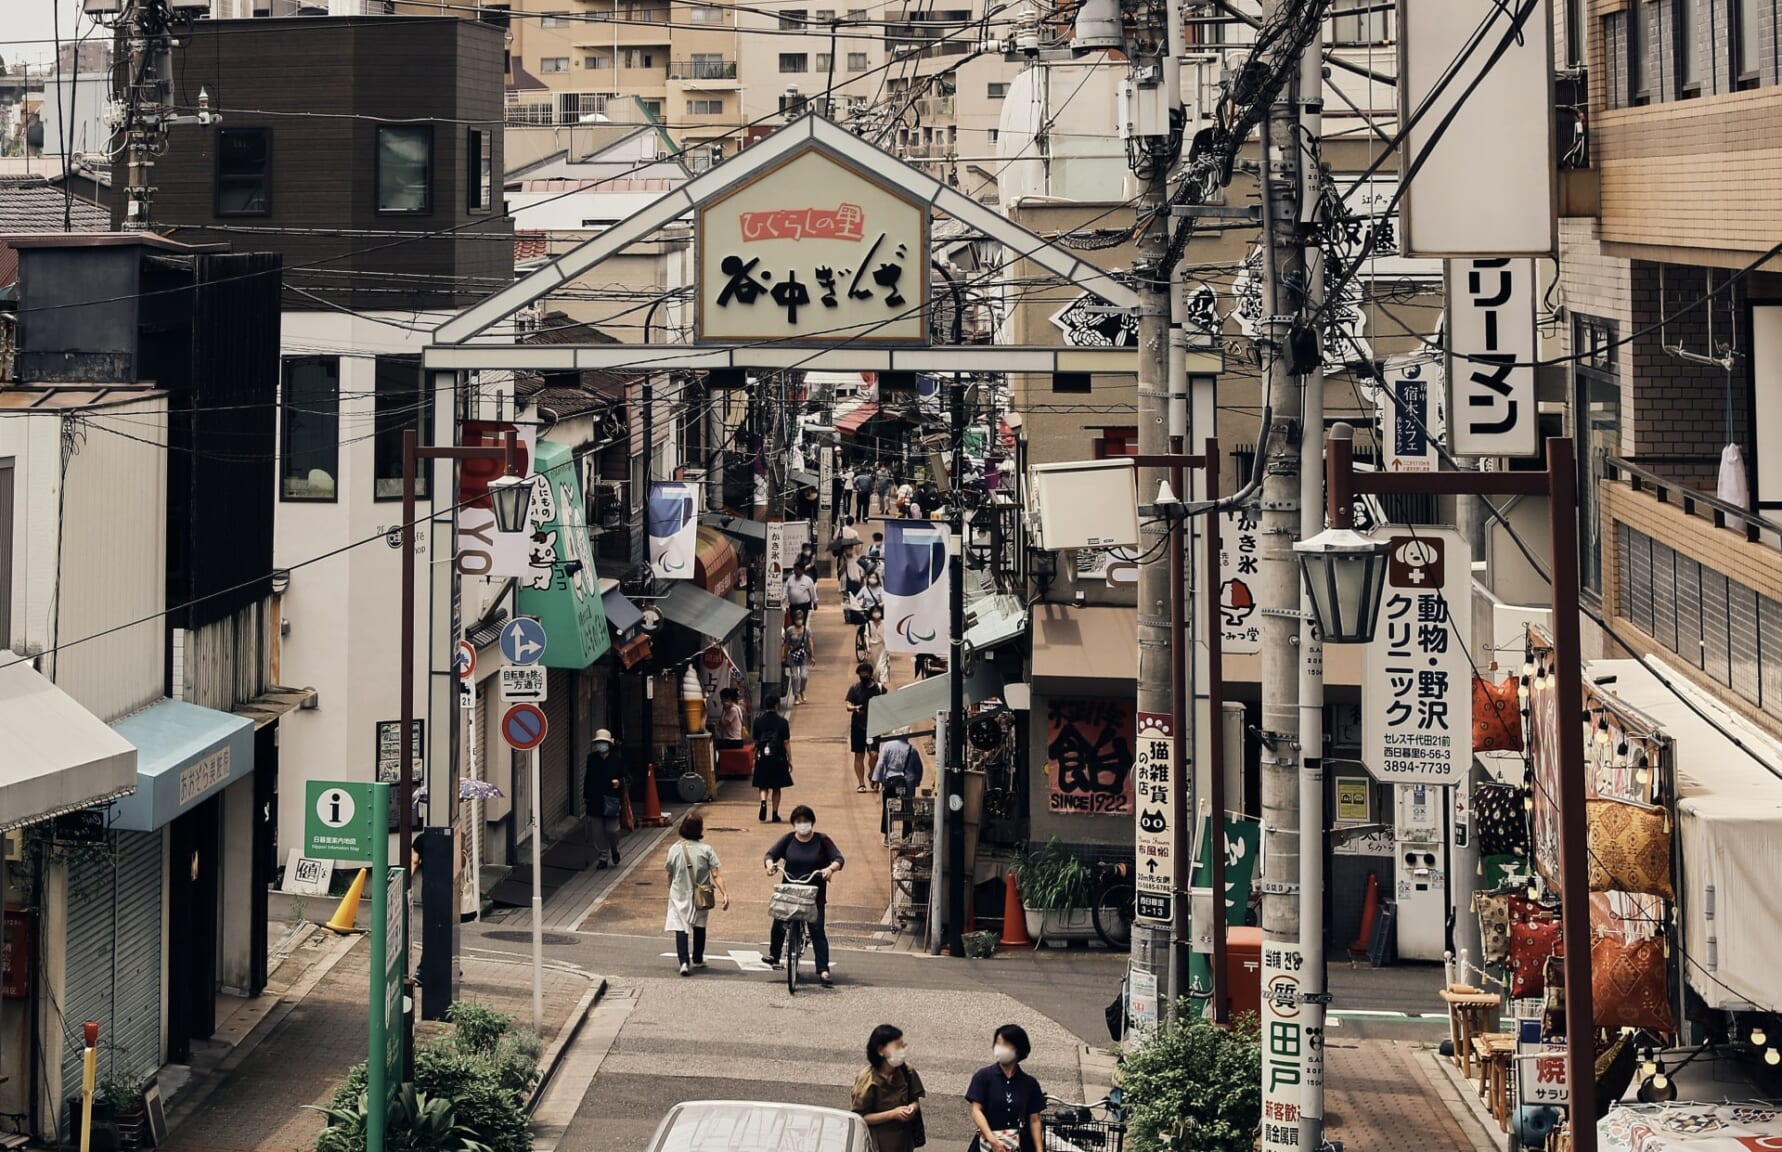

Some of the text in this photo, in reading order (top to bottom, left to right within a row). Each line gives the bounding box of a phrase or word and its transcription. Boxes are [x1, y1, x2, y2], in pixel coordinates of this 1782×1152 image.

[743, 203, 864, 241] ひぐらしの里
[716, 232, 908, 325] 谷中ぎんざ
[503, 670, 543, 681] 自転車を除く
[1385, 593, 1414, 727] クリニック
[1417, 594, 1448, 730] 動物・野沢
[504, 681, 543, 690] 一方通行
[1384, 734, 1451, 747] セレス千代田21前
[1384, 747, 1451, 760] 西日暮里6-56-3
[1138, 752, 1148, 796] のお店
[1150, 741, 1170, 804] 猫雑貨
[1384, 760, 1451, 775] 3894-7739
[1270, 1021, 1300, 1094] 田戸
